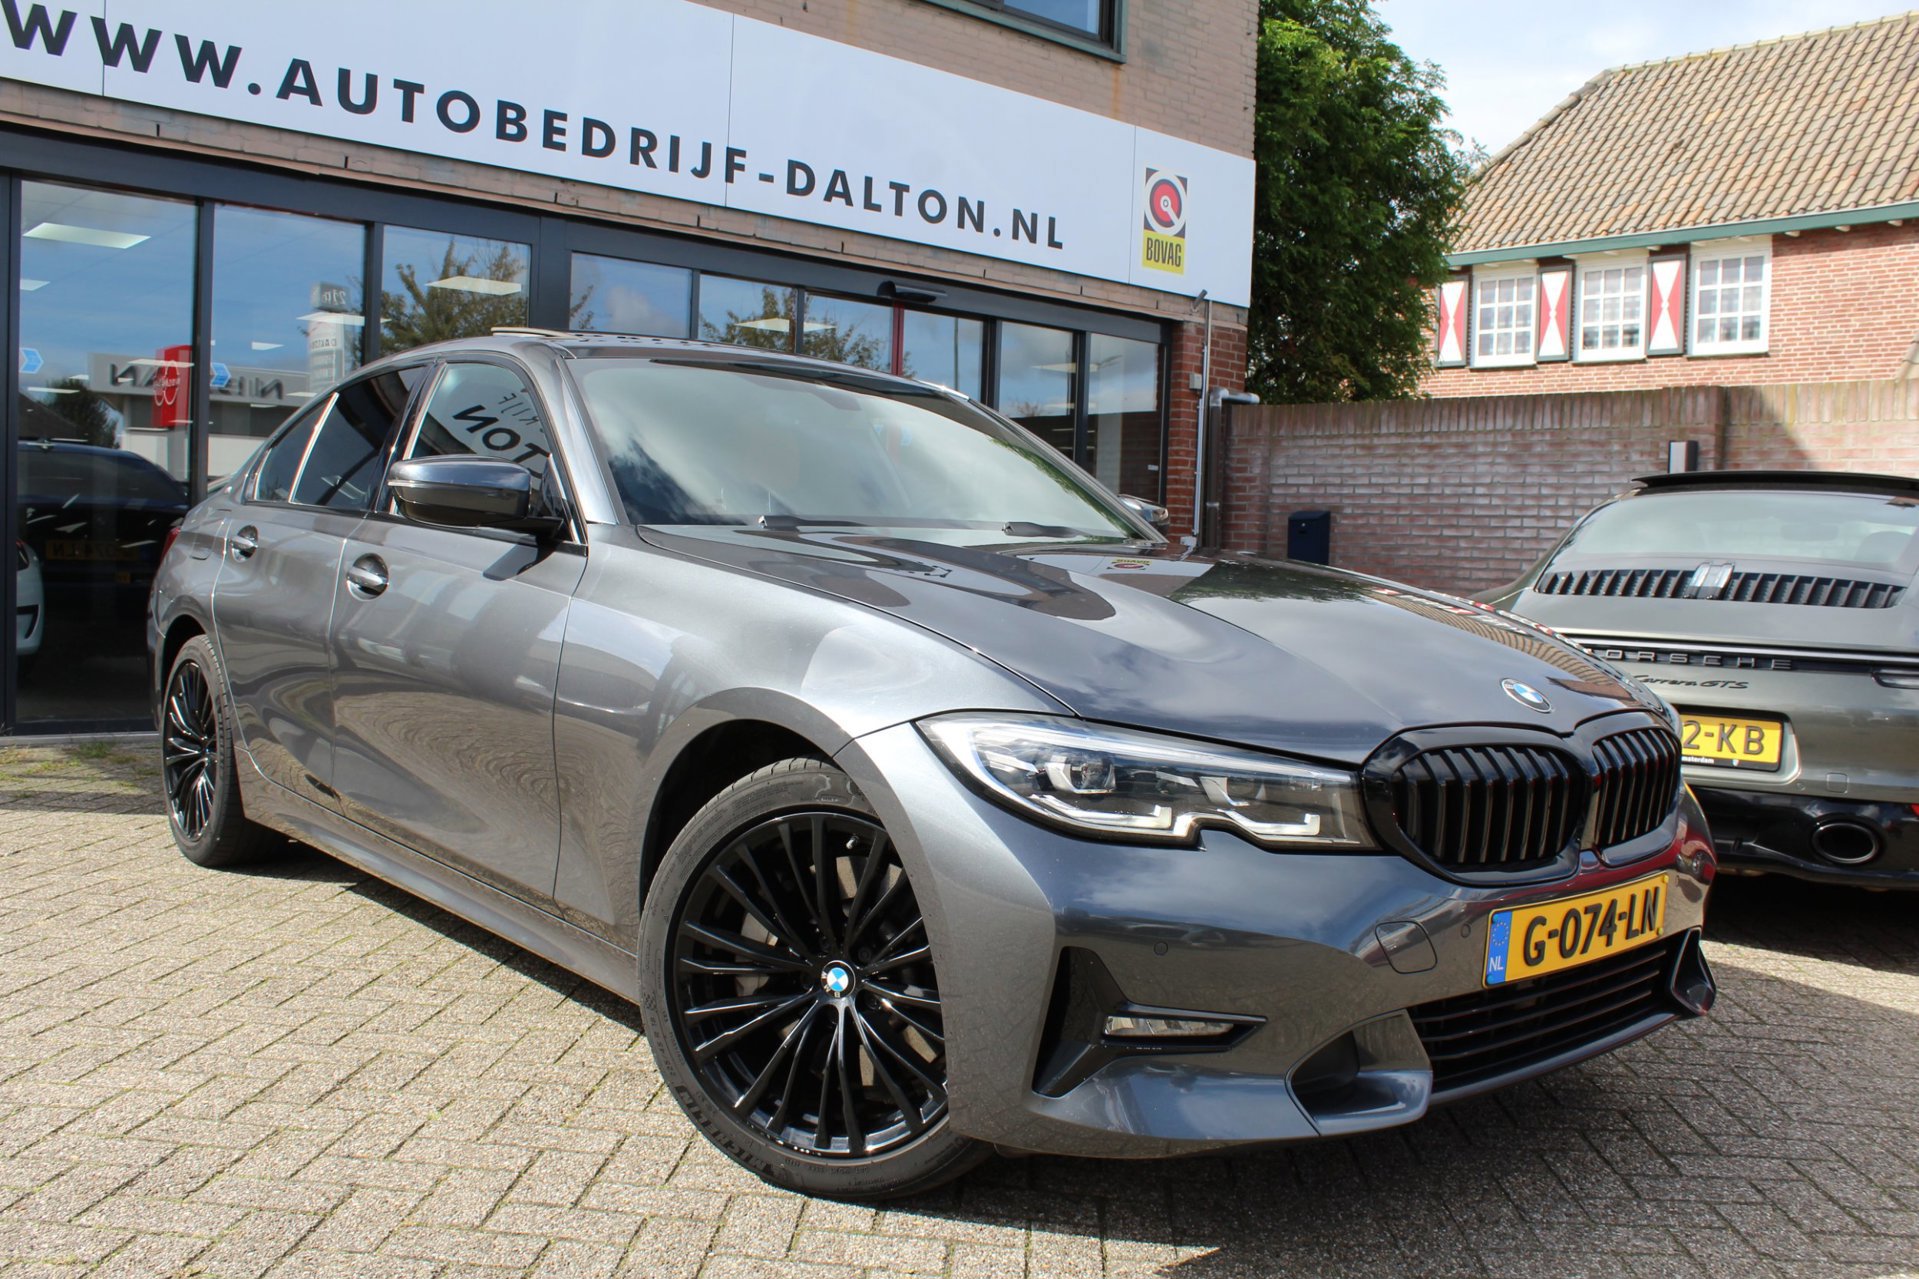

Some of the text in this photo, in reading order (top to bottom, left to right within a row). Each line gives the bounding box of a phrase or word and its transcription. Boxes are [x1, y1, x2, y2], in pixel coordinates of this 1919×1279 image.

[1, 0, 1064, 249] WWW.AUTOBEDRIJF-DALTON.NL
[1146, 237, 1182, 267] BOVAG
[1605, 649, 1792, 670] ORSCHE
[1699, 679, 1750, 690] GTS
[1683, 720, 1766, 756] 2-KB
[1524, 886, 1661, 967] G-074-LN
[1489, 957, 1504, 972] NL
[676, 1086, 769, 1172] MICHELIN
